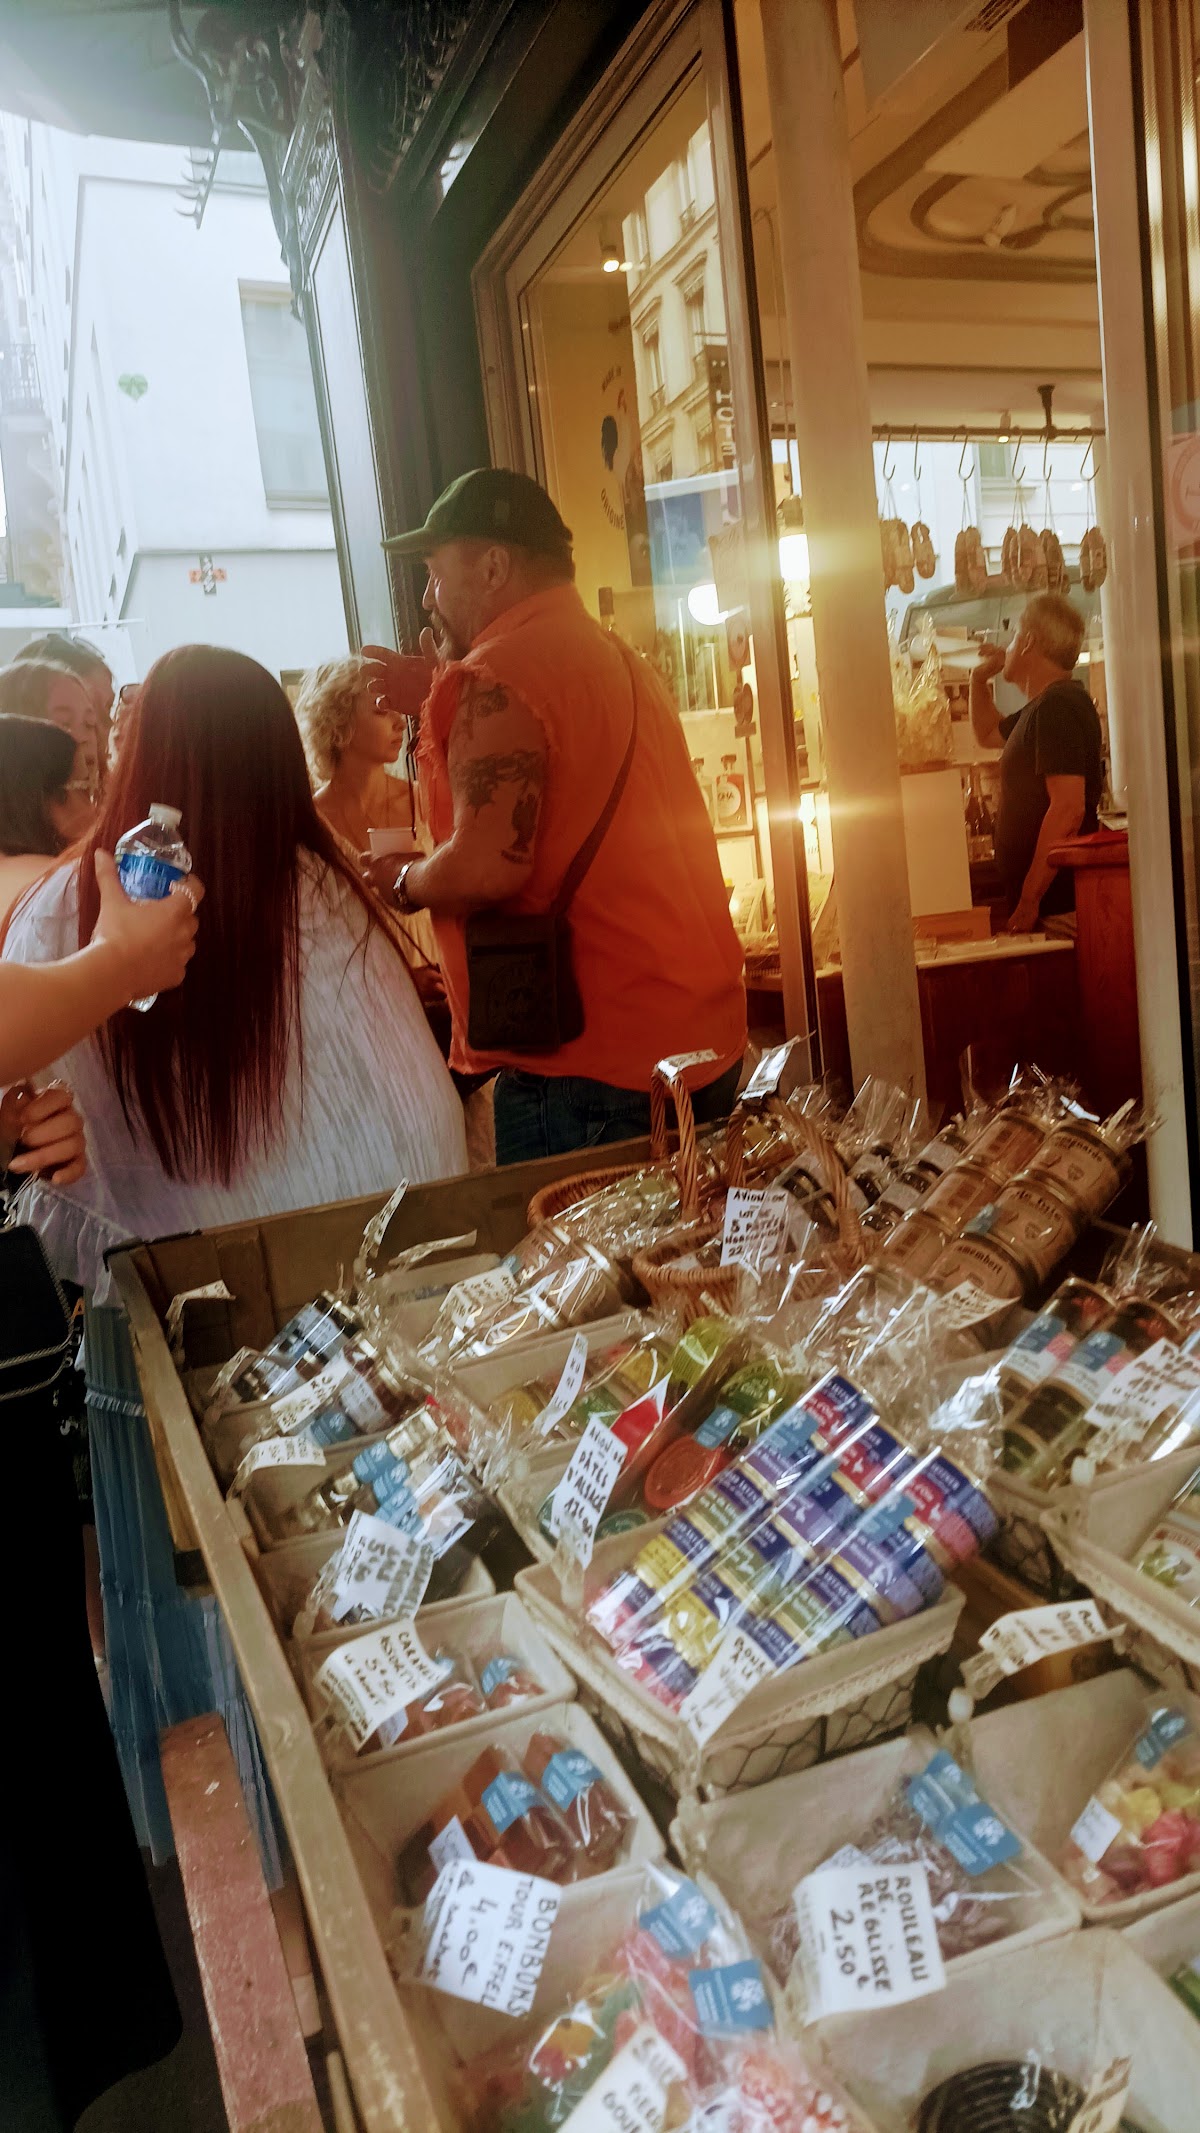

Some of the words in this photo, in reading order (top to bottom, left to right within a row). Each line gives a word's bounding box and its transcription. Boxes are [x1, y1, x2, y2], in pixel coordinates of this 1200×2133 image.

[589, 1425, 613, 1452] AVION
[504, 1878, 535, 1931] TOUR
[874, 1877, 894, 1903] DE
[506, 1897, 558, 2014] BONBONS
[895, 1875, 930, 1982] ROULEAU
[481, 1939, 514, 2004] EIFFEL
